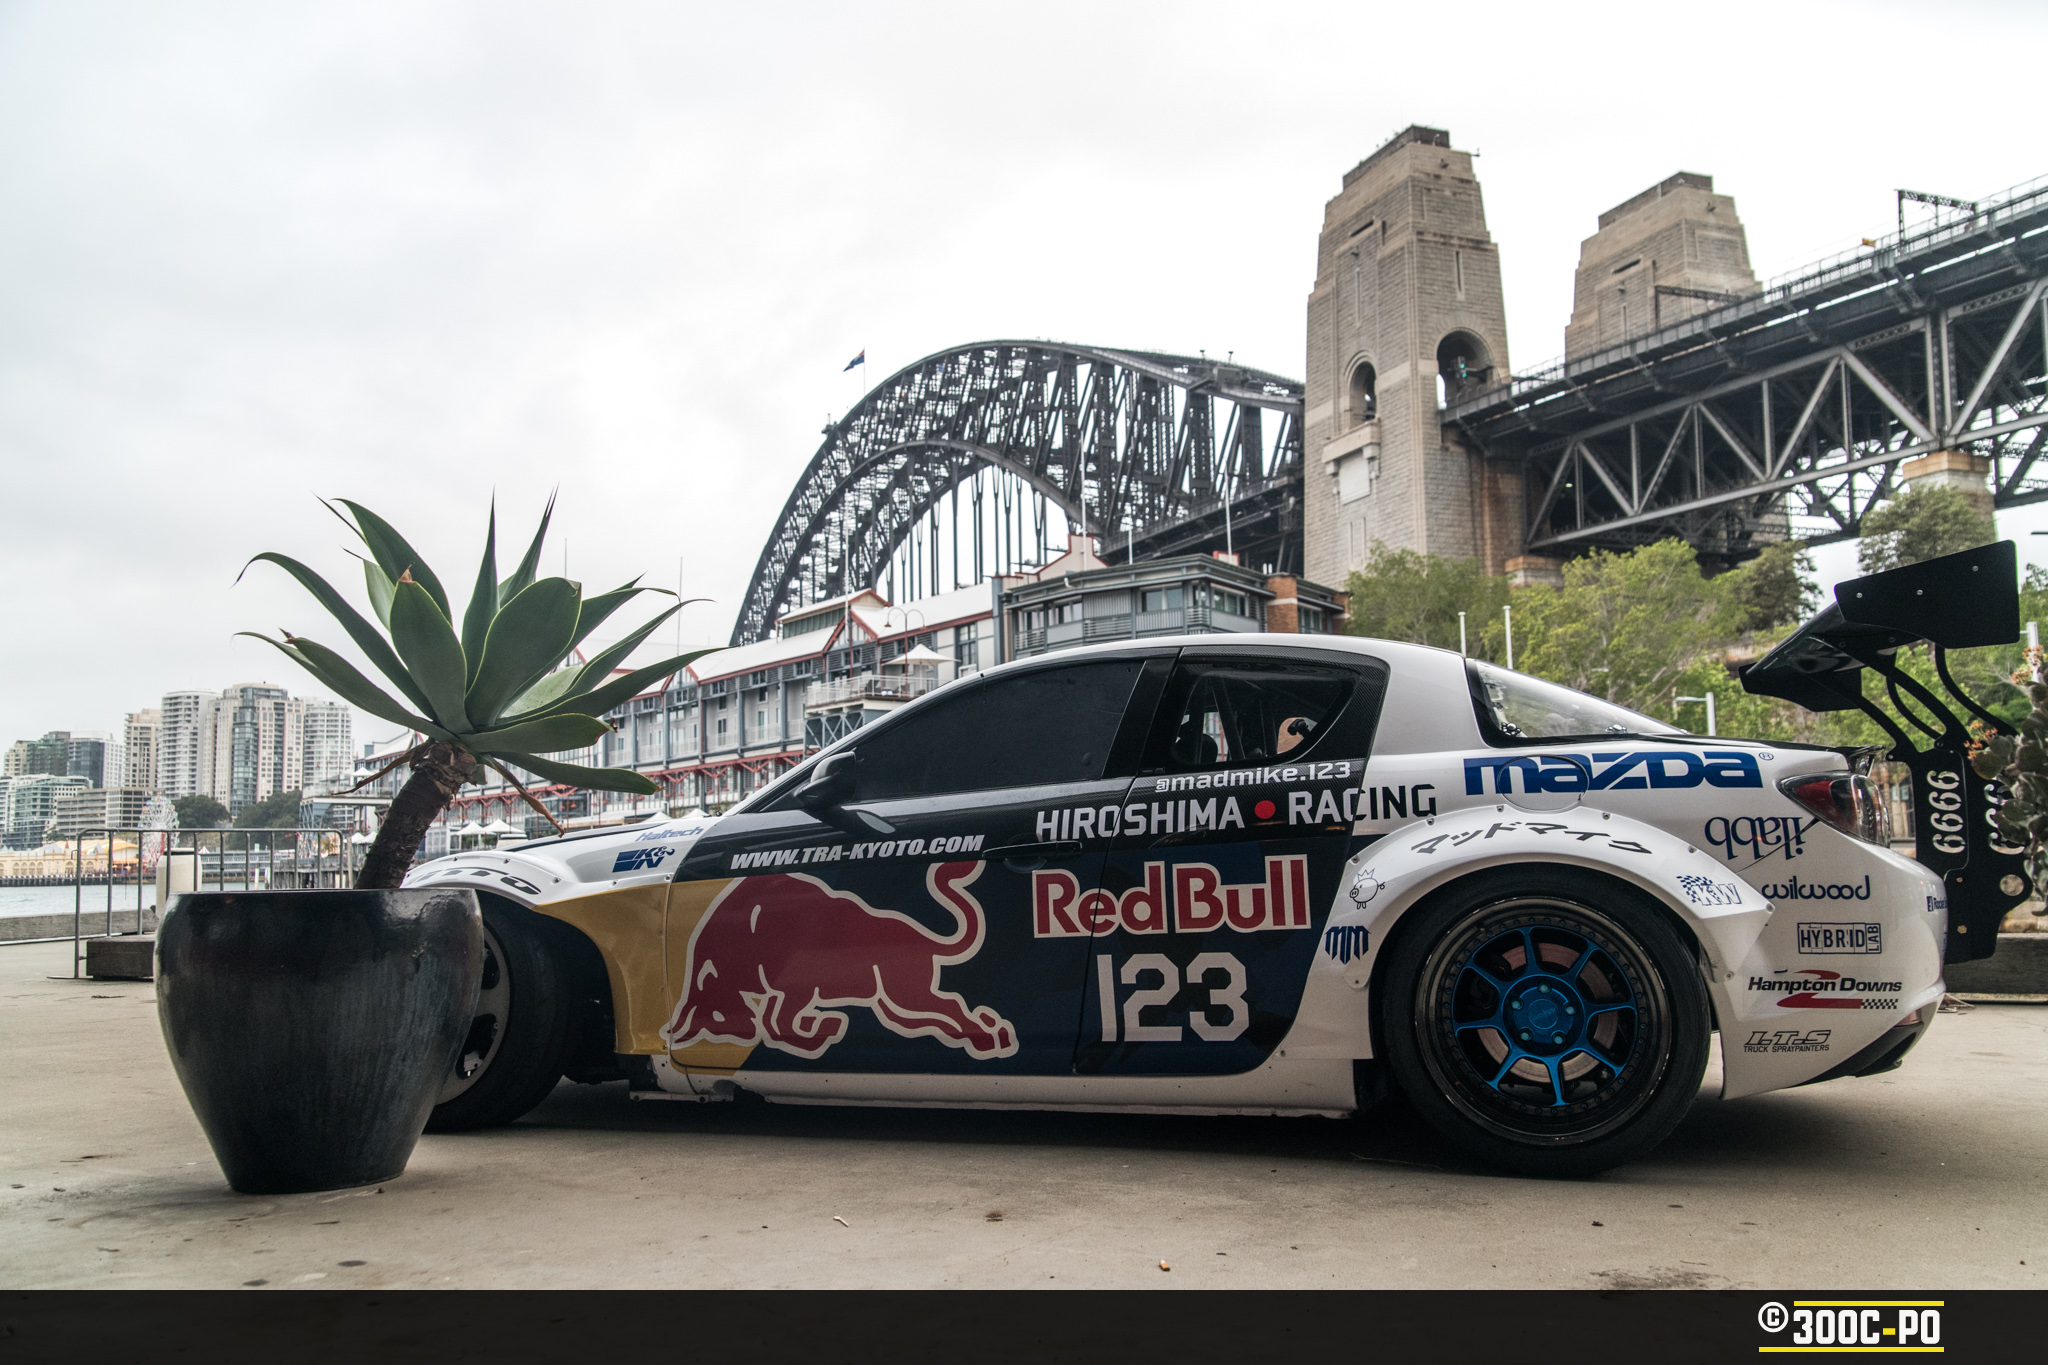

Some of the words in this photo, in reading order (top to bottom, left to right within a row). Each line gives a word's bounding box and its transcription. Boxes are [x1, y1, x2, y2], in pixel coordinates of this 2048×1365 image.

[1155, 762, 1350, 792] @madmike.123
[1036, 796, 1245, 842] HIROSHIMA
[1288, 784, 1437, 825] RACING
[635, 826, 704, 842] Haltech
[730, 835, 984, 869] WWW.TRA-KYOTO.COM
[1692, 883, 1742, 906] KW
[1761, 875, 1871, 900] wilwood
[1800, 929, 1865, 948] HYBRID
[1867, 926, 1879, 951] LAB
[1097, 952, 1249, 1042] 123
[1748, 976, 1836, 994] Hampton
[1839, 978, 1902, 992] Downs
[1743, 1045, 1769, 1053] TRUCK
[1772, 1044, 1830, 1053] SPRAYPAINTERS
